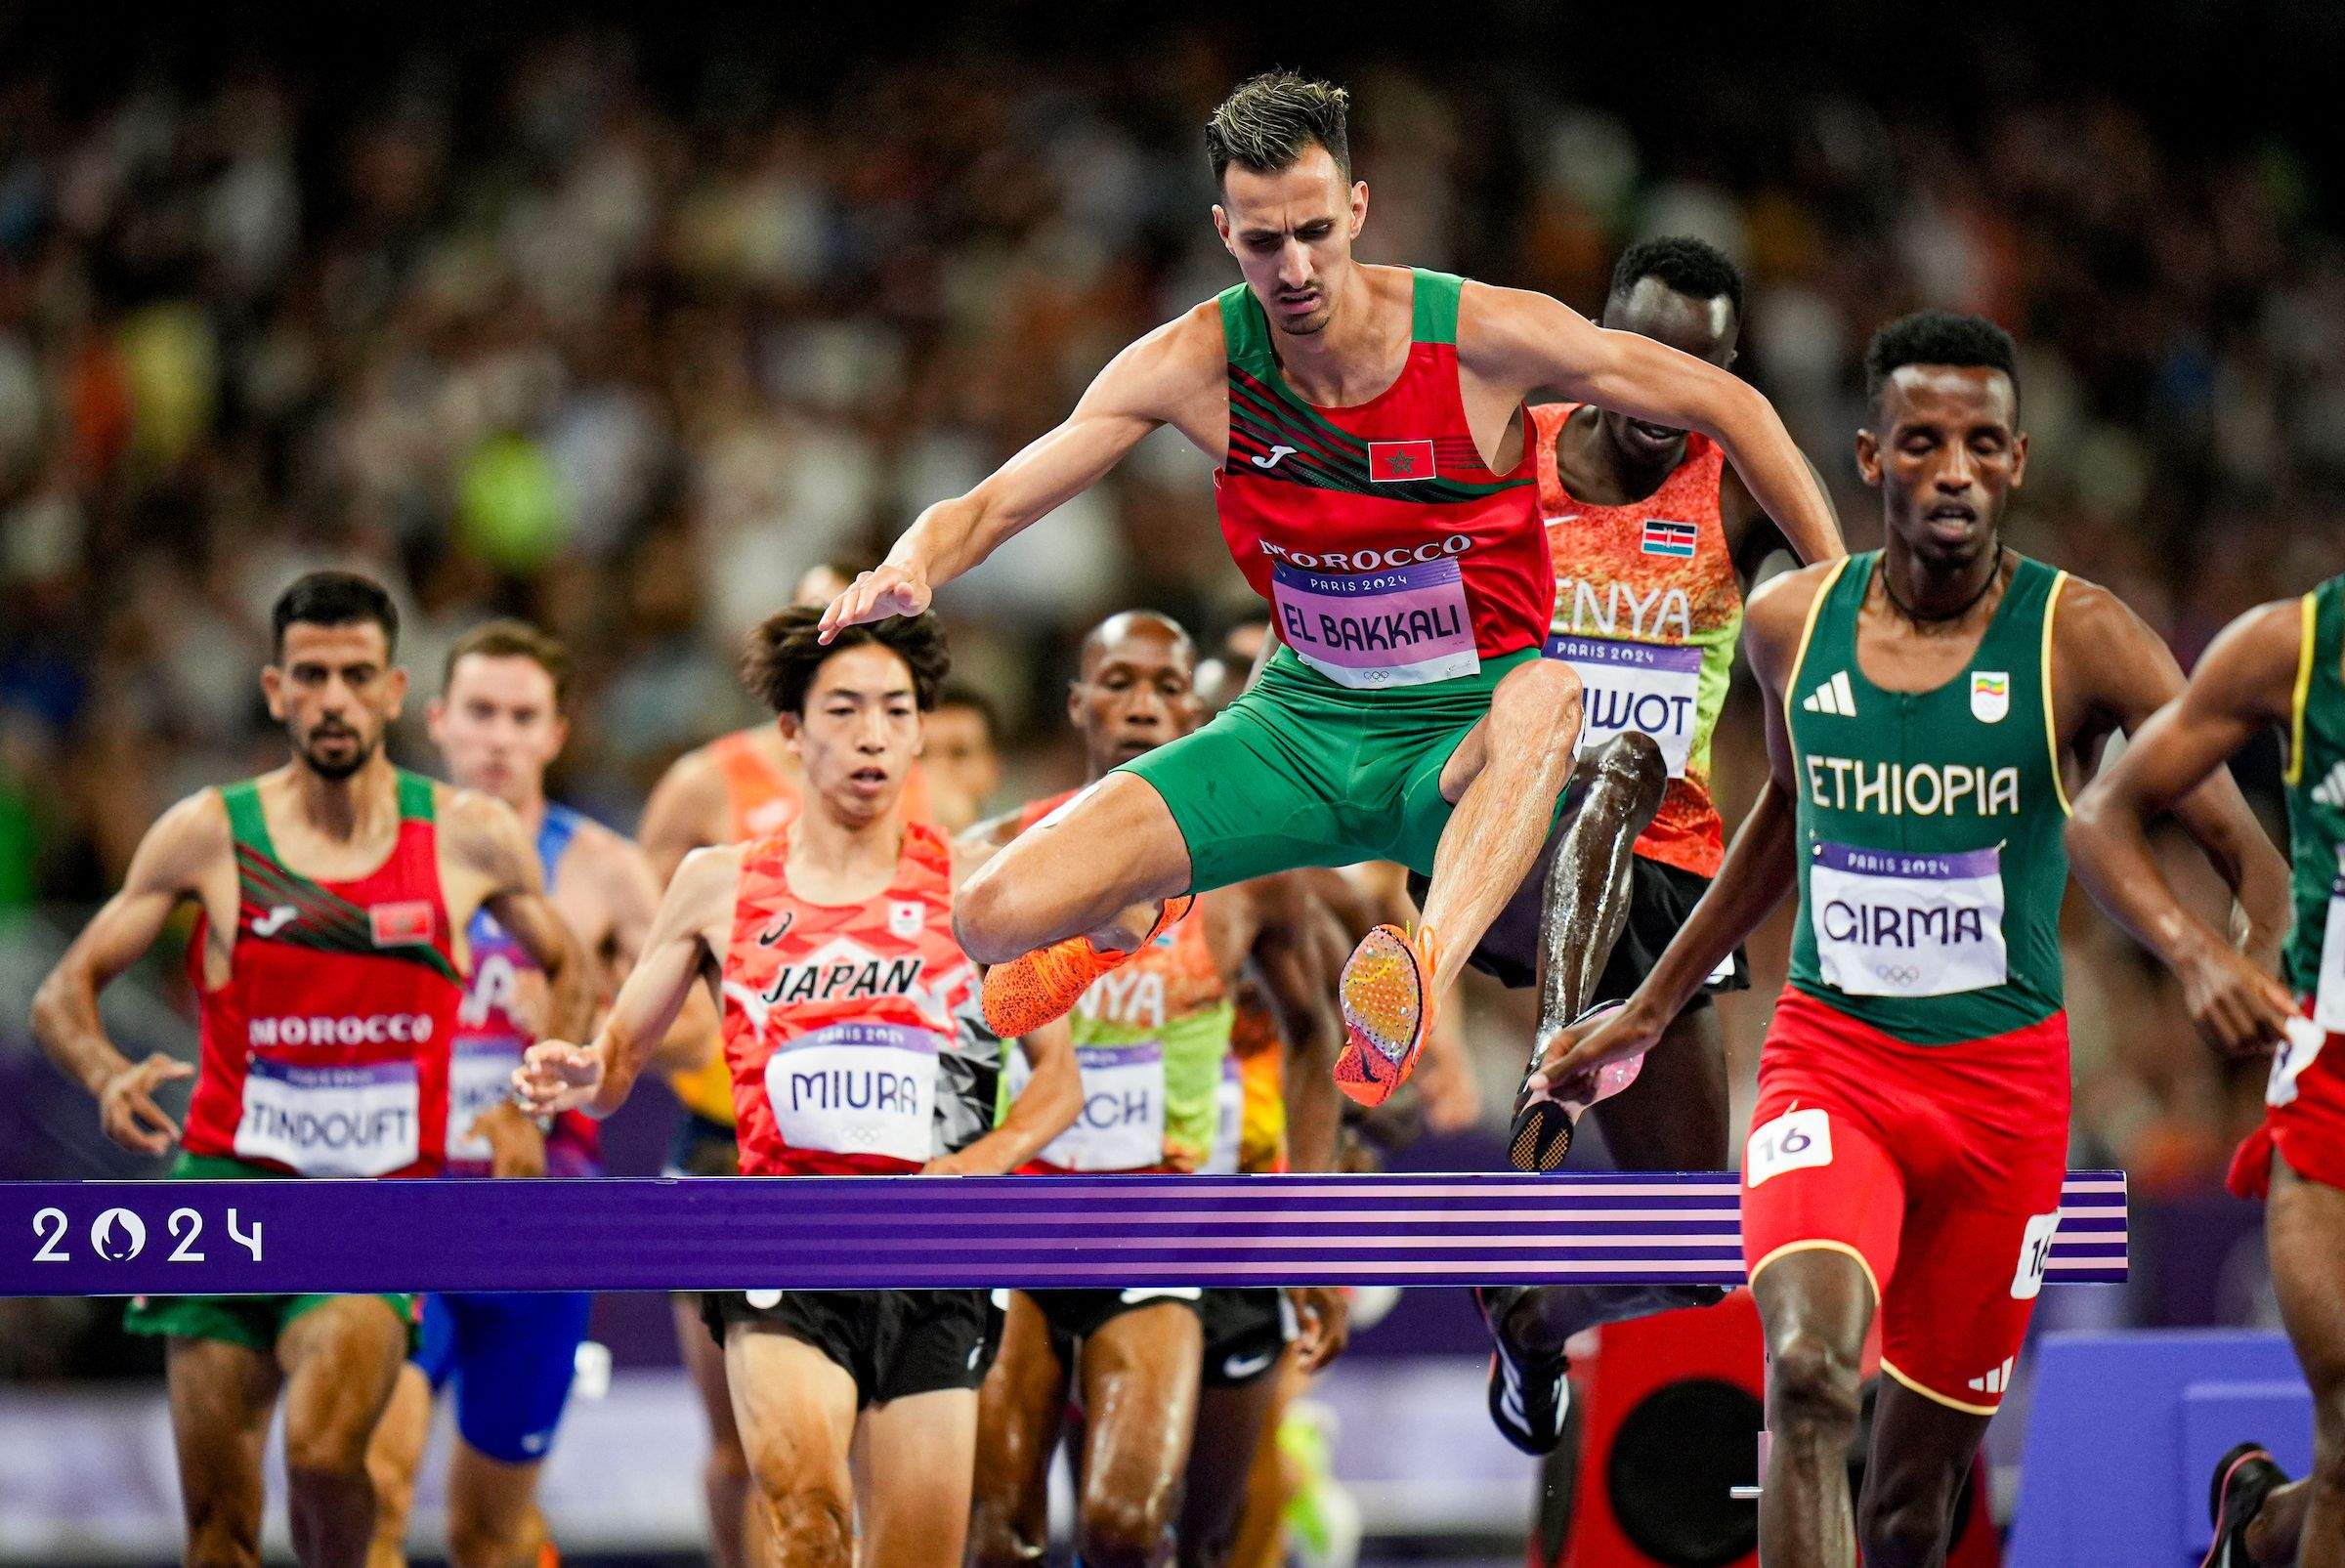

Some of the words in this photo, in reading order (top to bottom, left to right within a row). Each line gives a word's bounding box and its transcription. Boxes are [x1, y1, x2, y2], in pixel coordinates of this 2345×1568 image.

[1257, 534, 1472, 571] MOROCCO
[1310, 578, 1356, 592] PARIS
[1362, 574, 1407, 591] 2024
[1282, 602, 1318, 643] EL
[1319, 604, 1462, 652] BAKKALI
[1550, 577, 1691, 641] ENYA
[1556, 641, 1605, 658] PARIS
[1610, 649, 1654, 664] 2024
[1806, 754, 2019, 817] ETHIOPIA
[1848, 853, 1896, 872] PARIS
[1901, 858, 1949, 875] 2024
[1824, 900, 1982, 948] GIRMA
[762, 959, 921, 1004] JAPAN
[248, 1012, 435, 1046] MOROCCO
[791, 1070, 917, 1116] MIURA
[252, 1100, 409, 1150] TINDOUFT
[1760, 1126, 1812, 1162] 16
[32, 1208, 262, 1261] 2024
